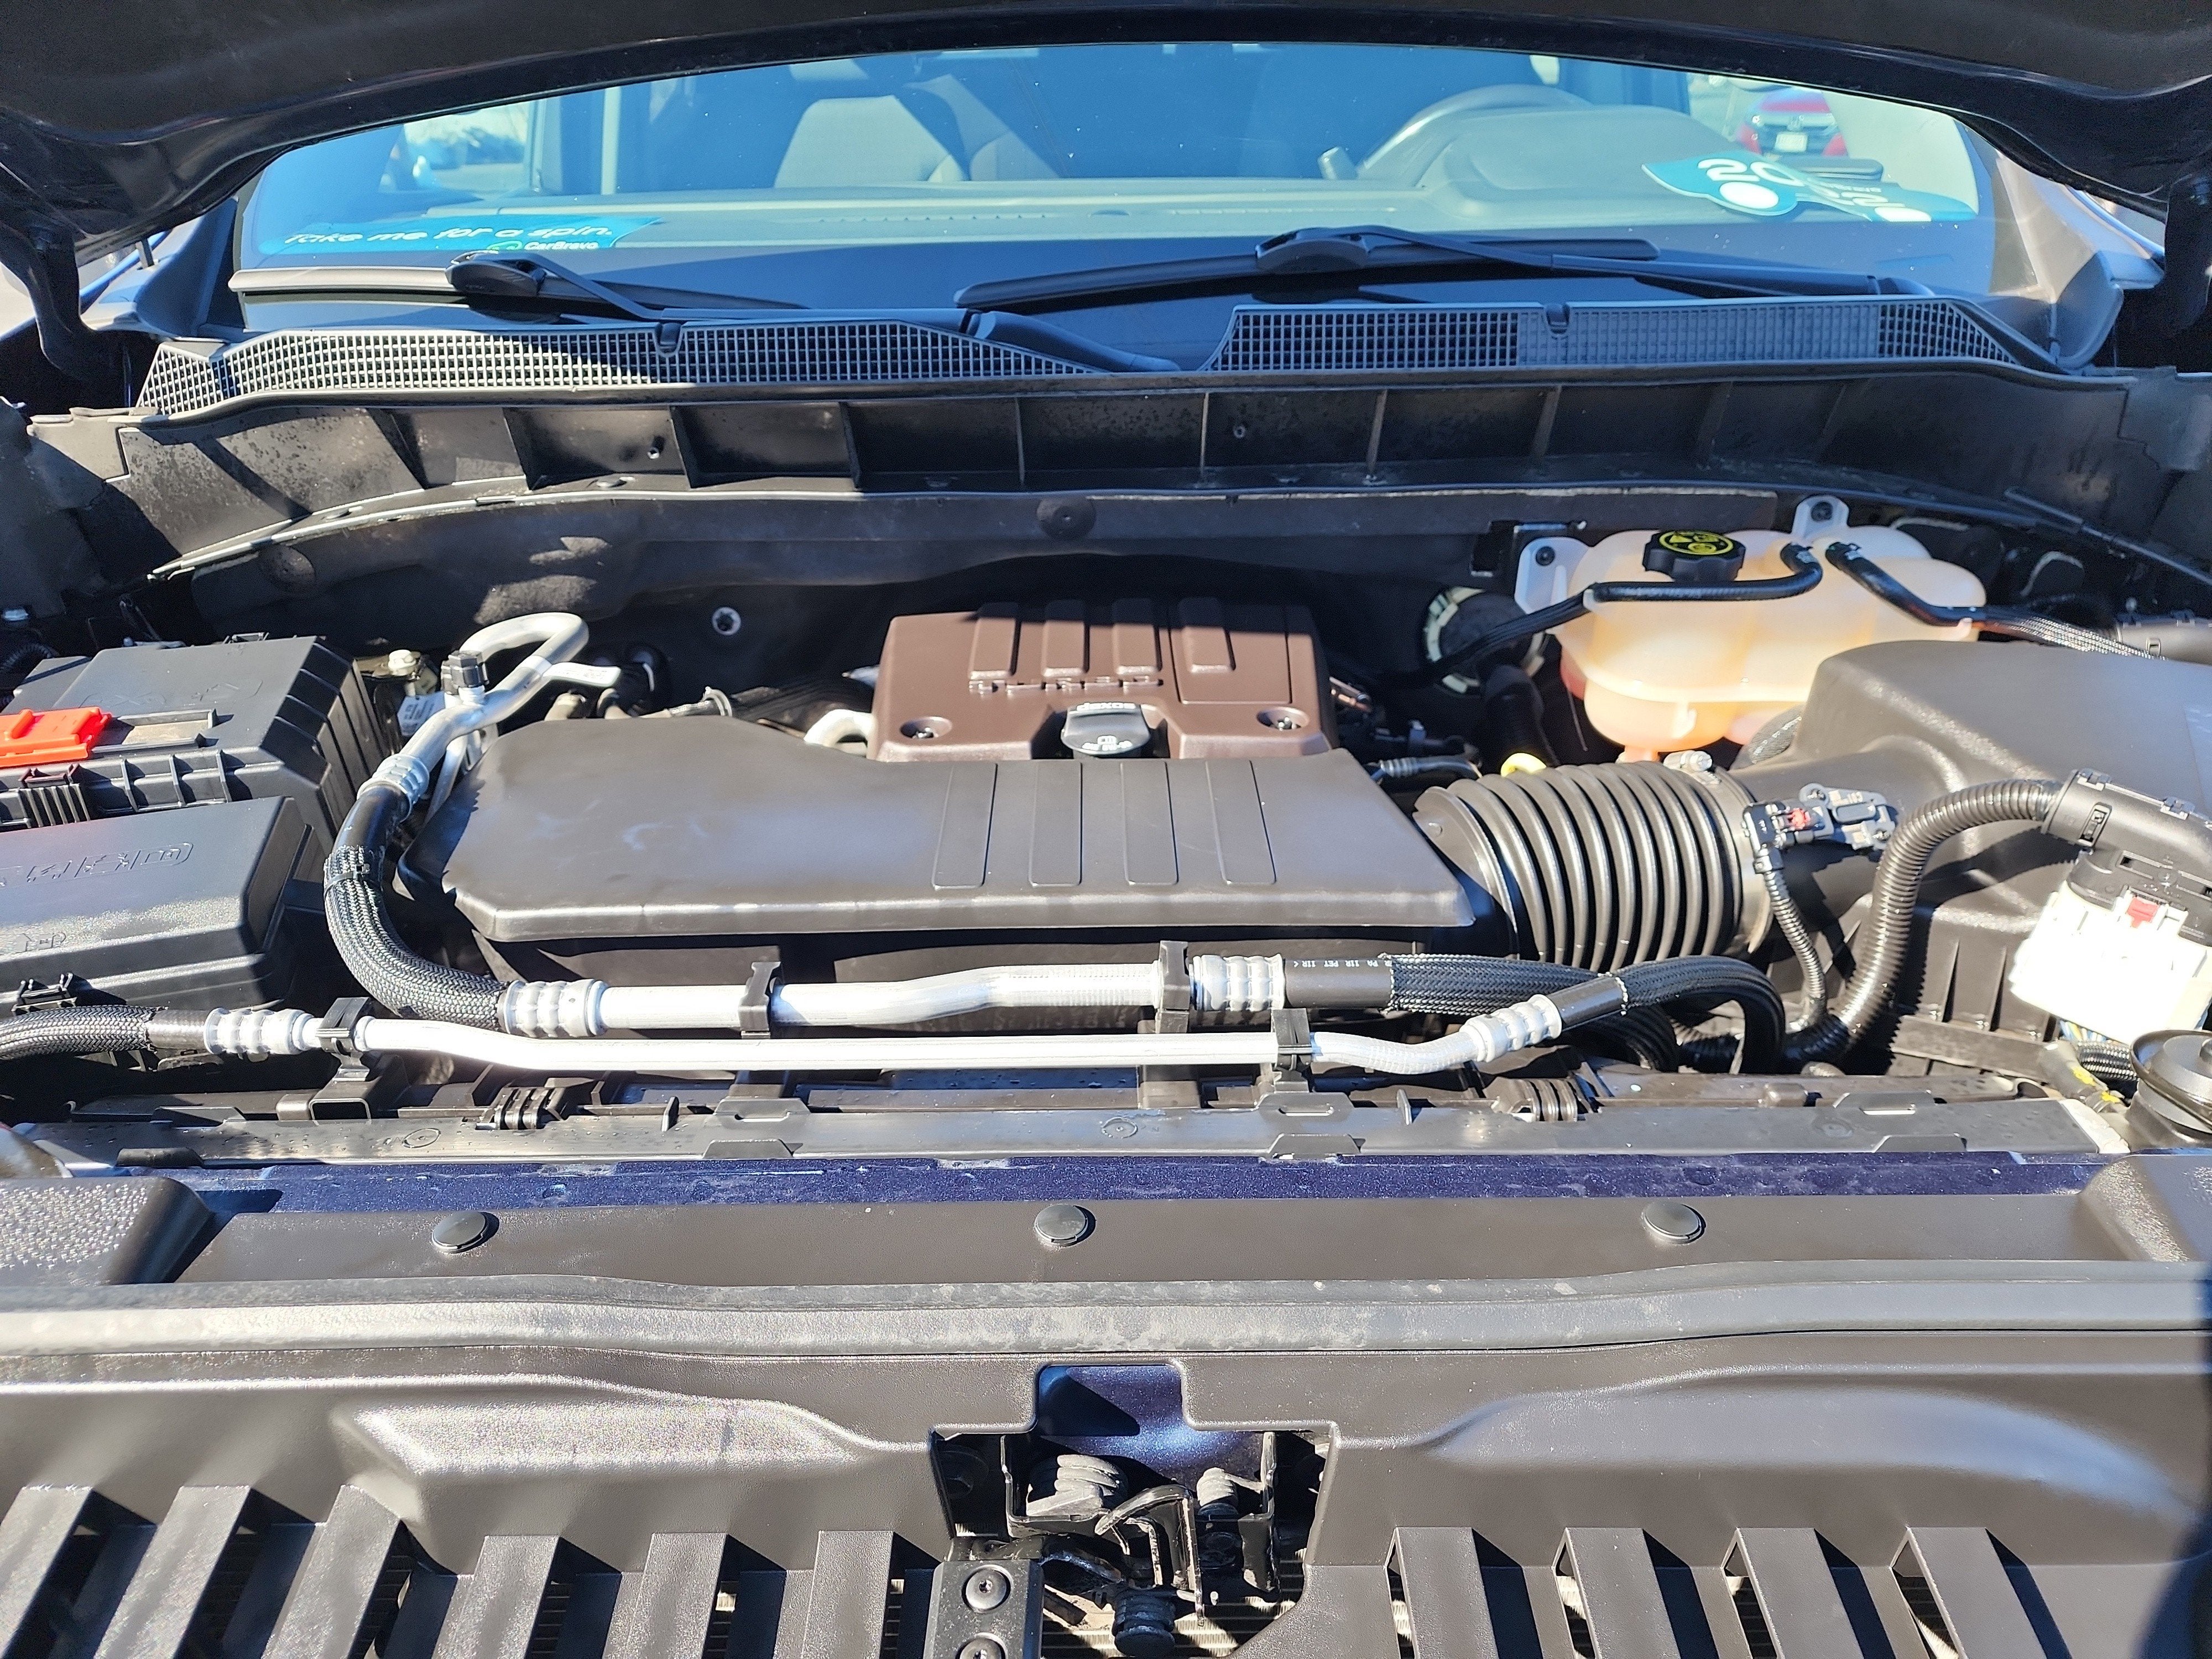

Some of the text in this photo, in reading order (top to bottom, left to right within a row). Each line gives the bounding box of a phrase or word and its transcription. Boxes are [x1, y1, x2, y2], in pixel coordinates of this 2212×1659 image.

[284, 226, 613, 244] Take me for a spin.
[524, 241, 599, 251] CarBravo
[1076, 702, 1136, 712] dexos
